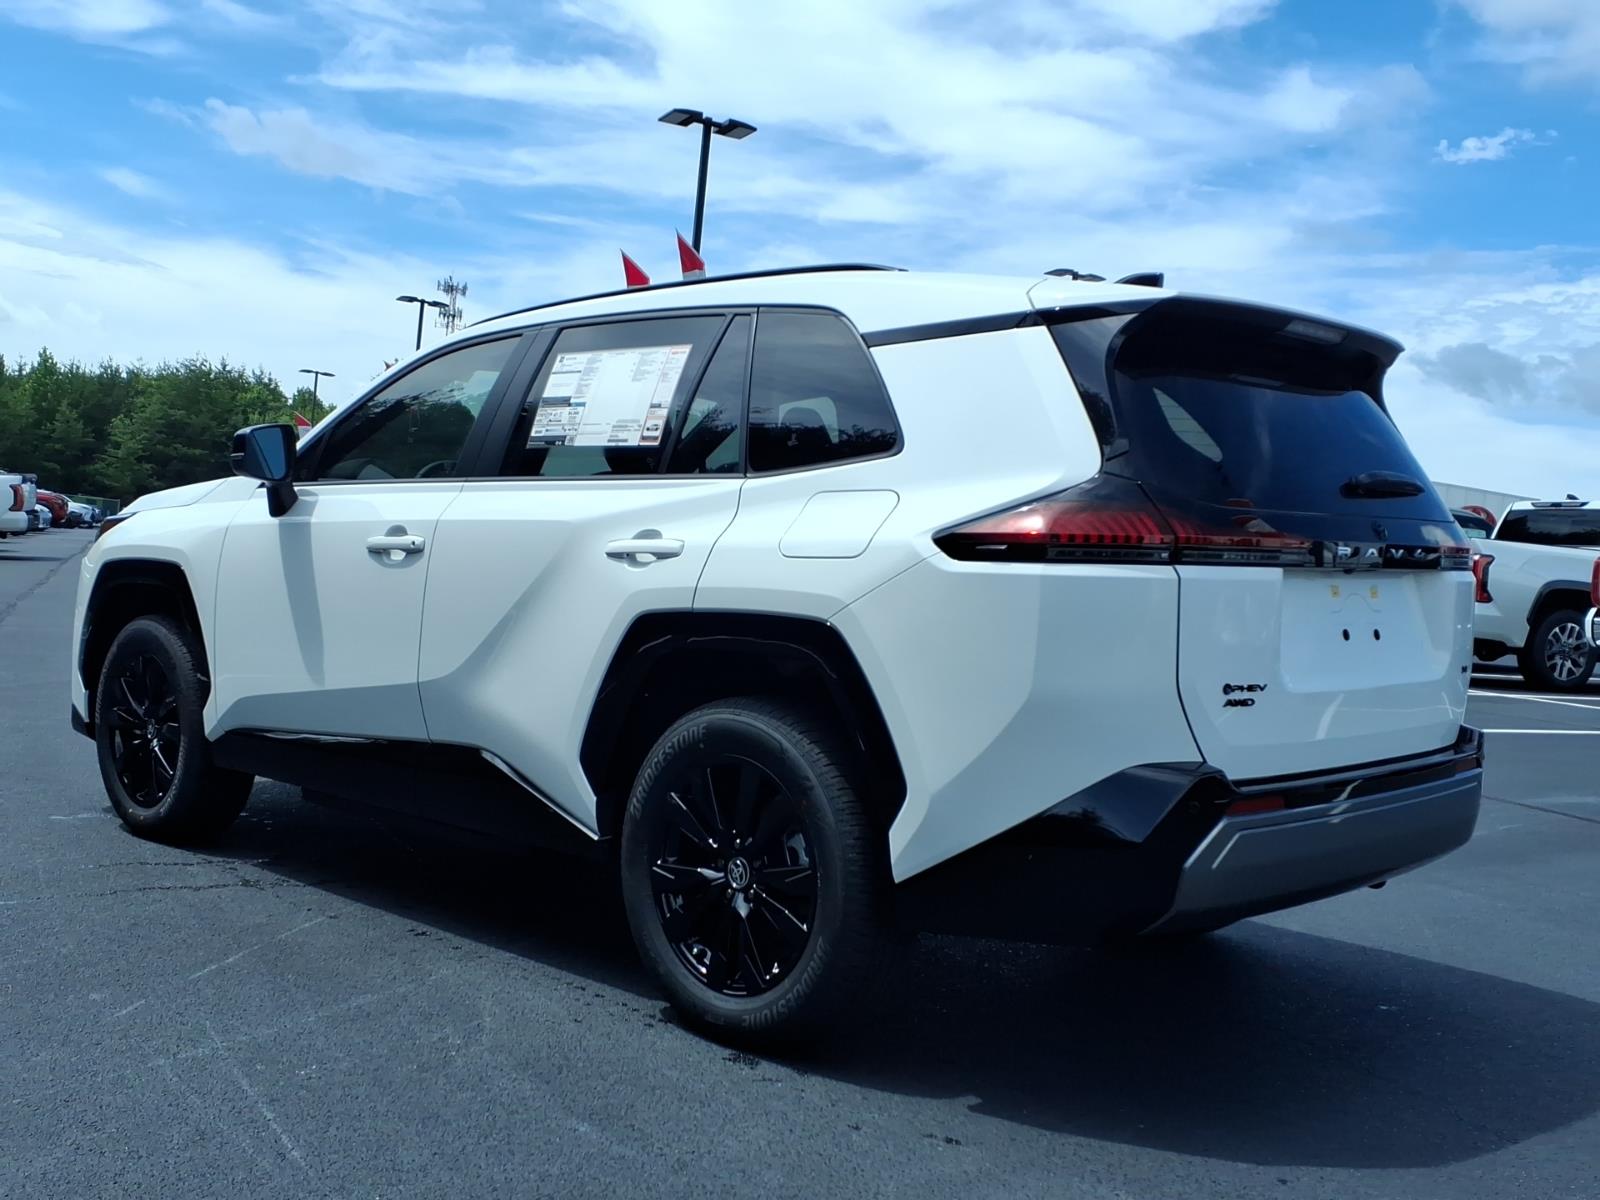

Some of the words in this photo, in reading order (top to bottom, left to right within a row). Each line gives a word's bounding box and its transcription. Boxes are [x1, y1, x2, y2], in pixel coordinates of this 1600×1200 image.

[1336, 546, 1427, 560] RAV4
[1231, 683, 1268, 693] PHEV
[1223, 698, 1255, 708] AWD
[629, 722, 707, 820] BRIDGESTONE
